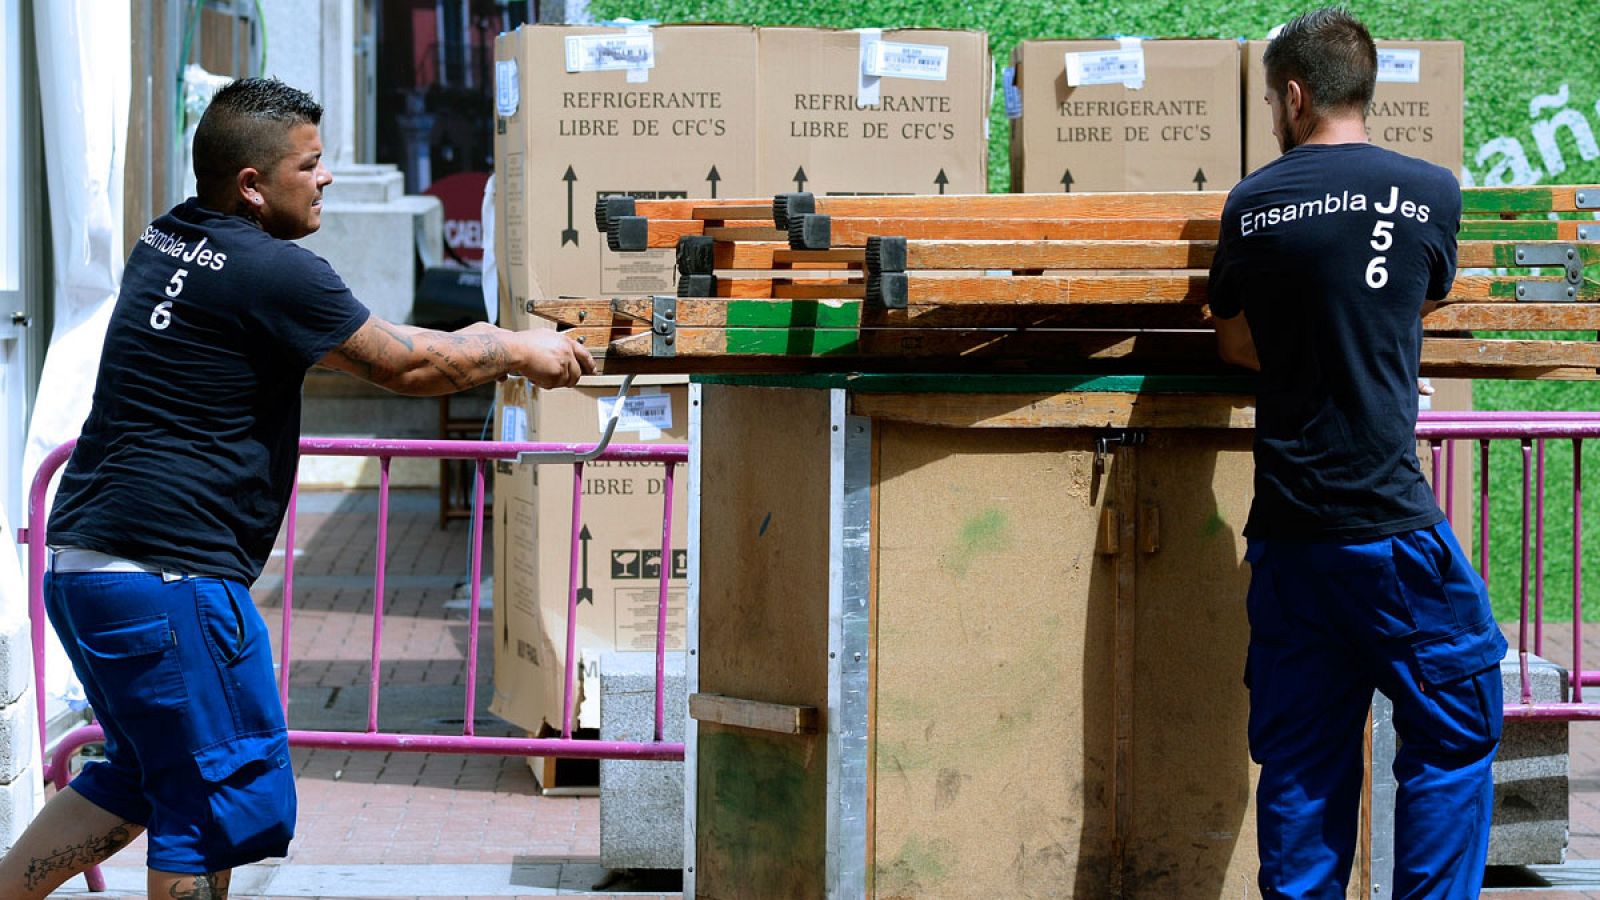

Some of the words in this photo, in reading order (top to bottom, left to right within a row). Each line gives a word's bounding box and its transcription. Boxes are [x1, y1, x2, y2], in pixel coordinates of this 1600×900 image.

[563, 91, 722, 109] REFRIGERANTE
[1059, 100, 1208, 117] REFRIGERANTE
[559, 119, 619, 137] LIBRE
[632, 119, 660, 137] DE
[671, 118, 726, 137] CFC'S
[790, 120, 849, 138] LIBRE
[862, 122, 889, 139] DE
[901, 122, 955, 141] CFC'S
[1057, 126, 1113, 143] LIBRE
[1124, 126, 1150, 142] DE
[1161, 125, 1211, 142] CFC'S
[1383, 125, 1433, 143] CFC'S
[1370, 220, 1395, 252] 5
[1365, 256, 1388, 289] 6
[165, 268, 188, 298] 5
[149, 301, 173, 330] 6
[580, 479, 634, 495] IBRE
[647, 479, 665, 495] D
